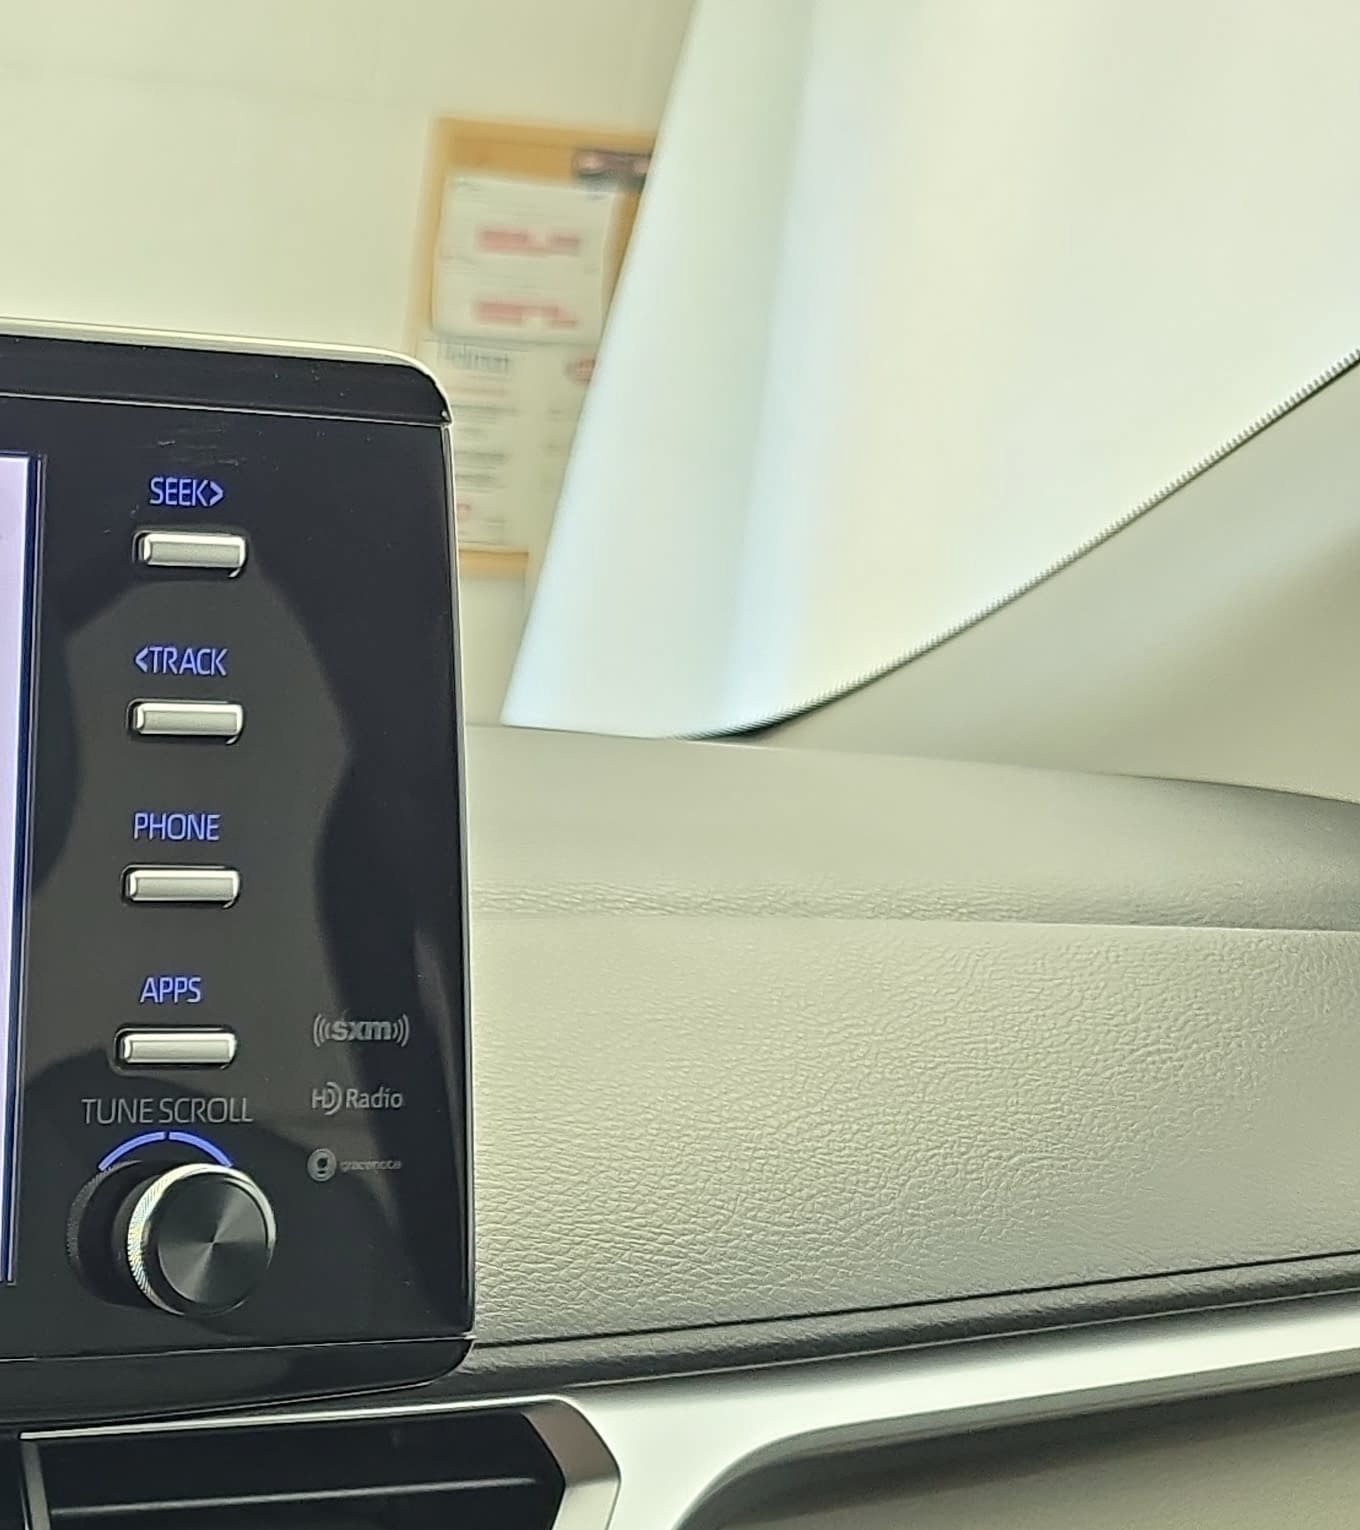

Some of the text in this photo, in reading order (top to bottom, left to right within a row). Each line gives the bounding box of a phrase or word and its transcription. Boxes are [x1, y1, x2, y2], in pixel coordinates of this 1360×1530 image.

[134, 812, 219, 841] PHONE
[140, 976, 201, 1004] APPS
[82, 1098, 253, 1123] TUNE SCROLL
[346, 1086, 404, 1109] Radio
